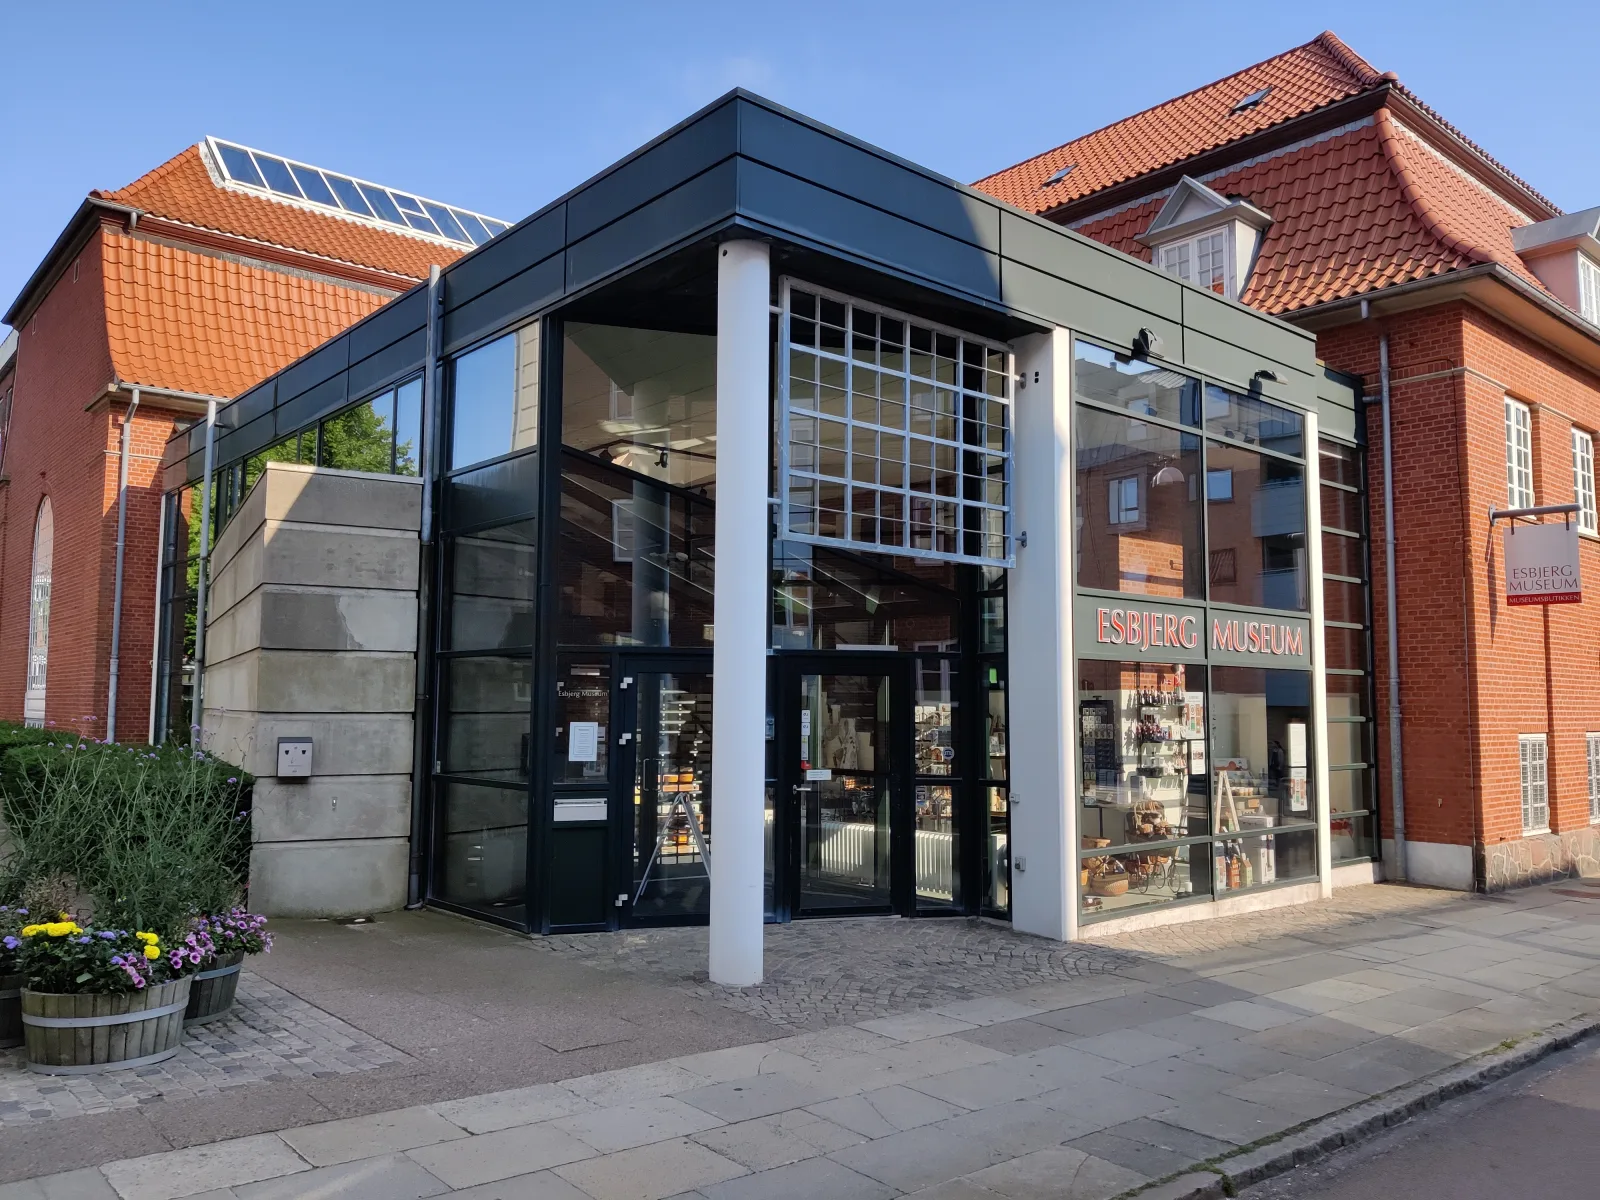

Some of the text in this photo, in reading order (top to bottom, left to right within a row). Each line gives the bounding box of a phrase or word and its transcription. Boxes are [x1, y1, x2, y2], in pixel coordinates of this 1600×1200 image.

[1513, 565, 1572, 579] ESBJERG
[1509, 578, 1578, 592] MUSEUM
[1509, 595, 1579, 603] MUSEUMSBUTIKKEN
[1096, 607, 1304, 656] ESBJERG MUSEUM
[558, 690, 580, 698] Esbjerg
